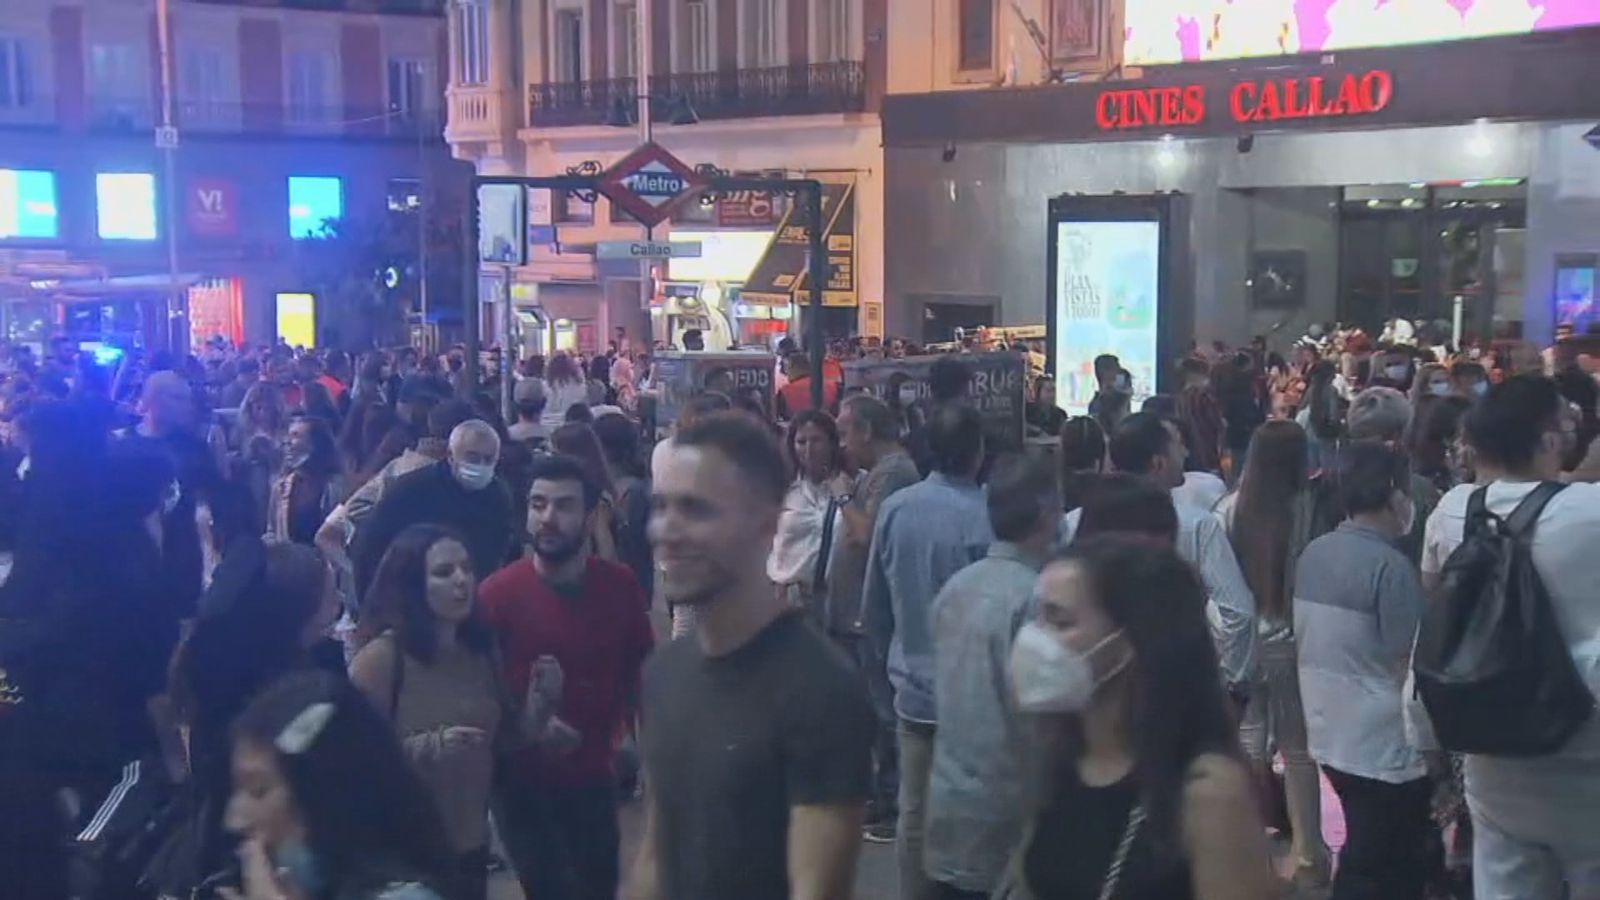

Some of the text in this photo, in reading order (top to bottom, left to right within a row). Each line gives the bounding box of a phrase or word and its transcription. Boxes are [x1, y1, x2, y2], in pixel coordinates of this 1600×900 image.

[1096, 70, 1392, 128] CINES CALLAO
[631, 174, 680, 192] Metro
[630, 242, 671, 255] Callao
